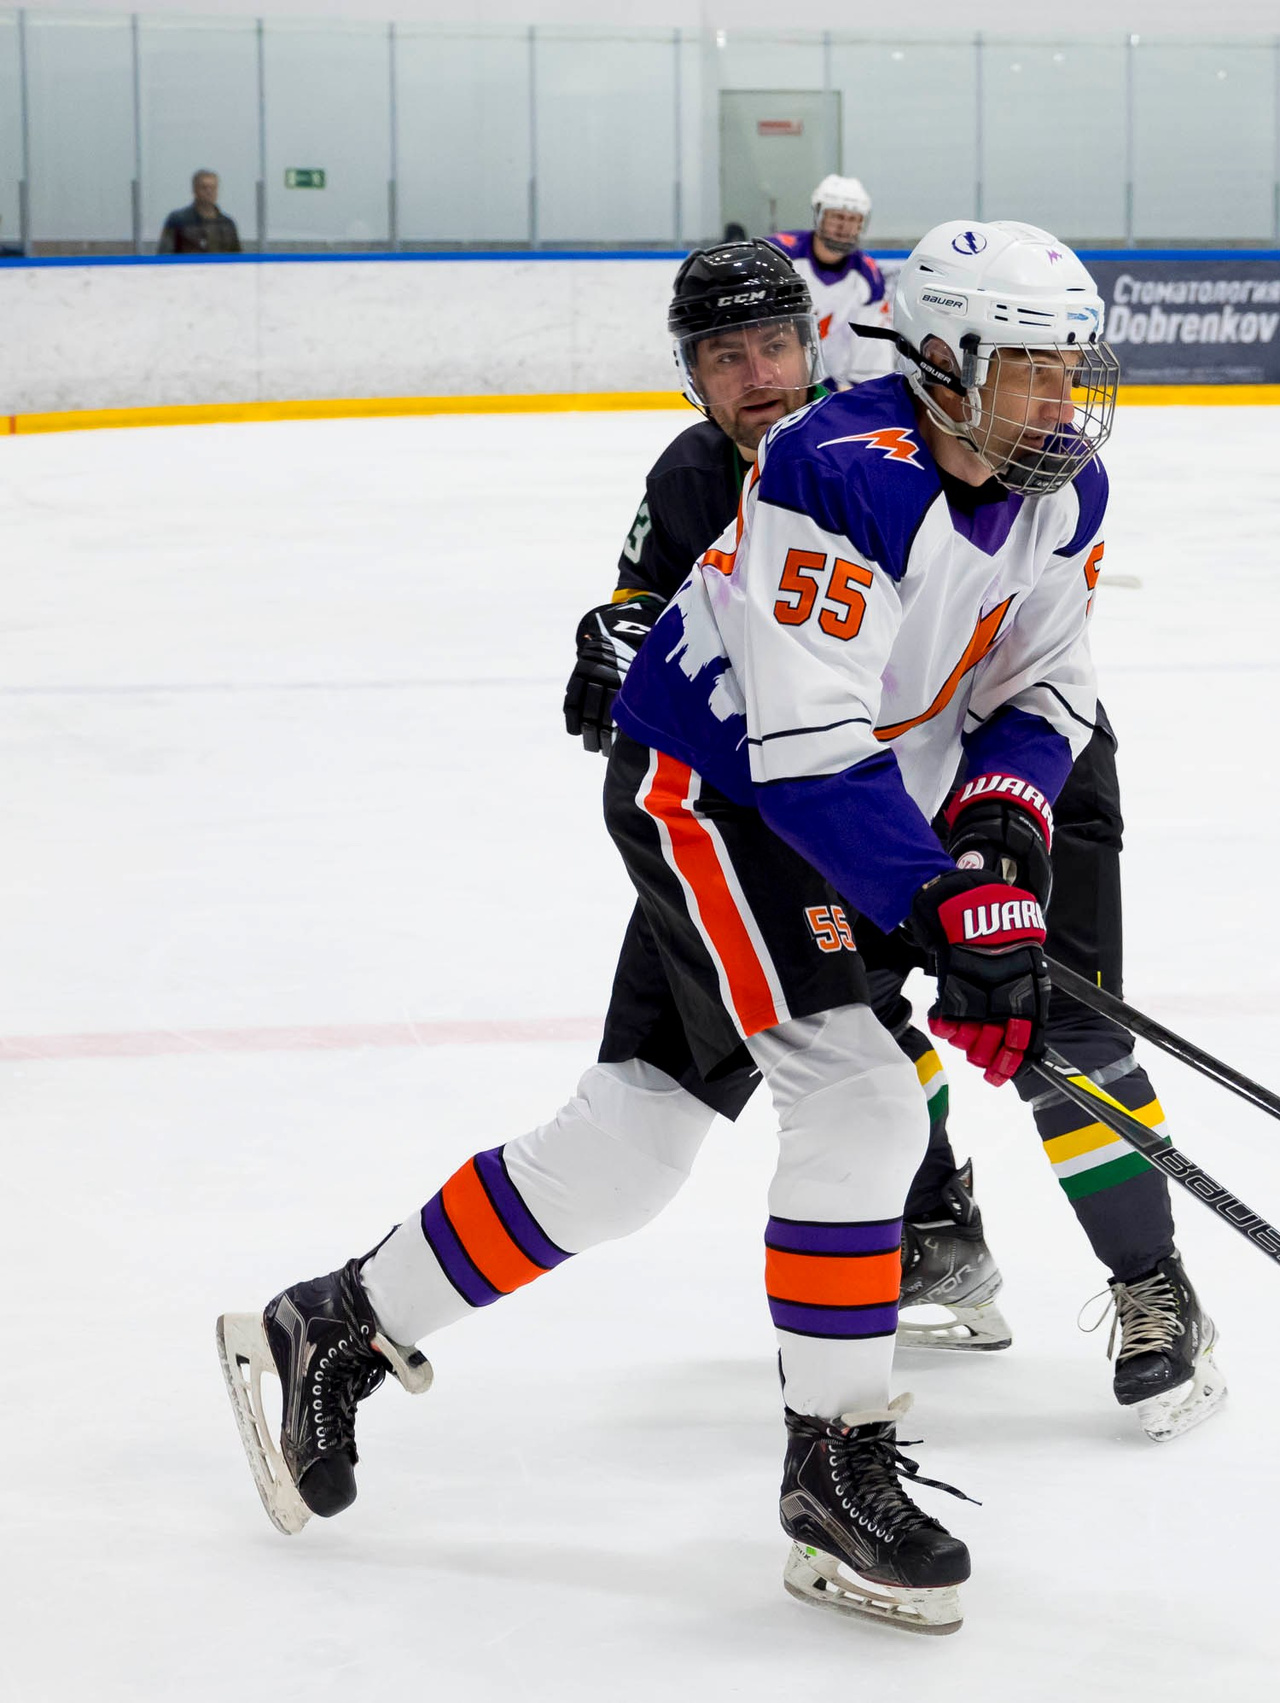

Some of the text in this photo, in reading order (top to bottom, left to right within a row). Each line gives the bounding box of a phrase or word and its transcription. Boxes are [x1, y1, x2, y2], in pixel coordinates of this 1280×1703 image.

[717, 290, 767, 308] CCM
[1105, 304, 1280, 345] Dobrenkov
[773, 547, 874, 641] 55
[803, 905, 857, 953] 55
